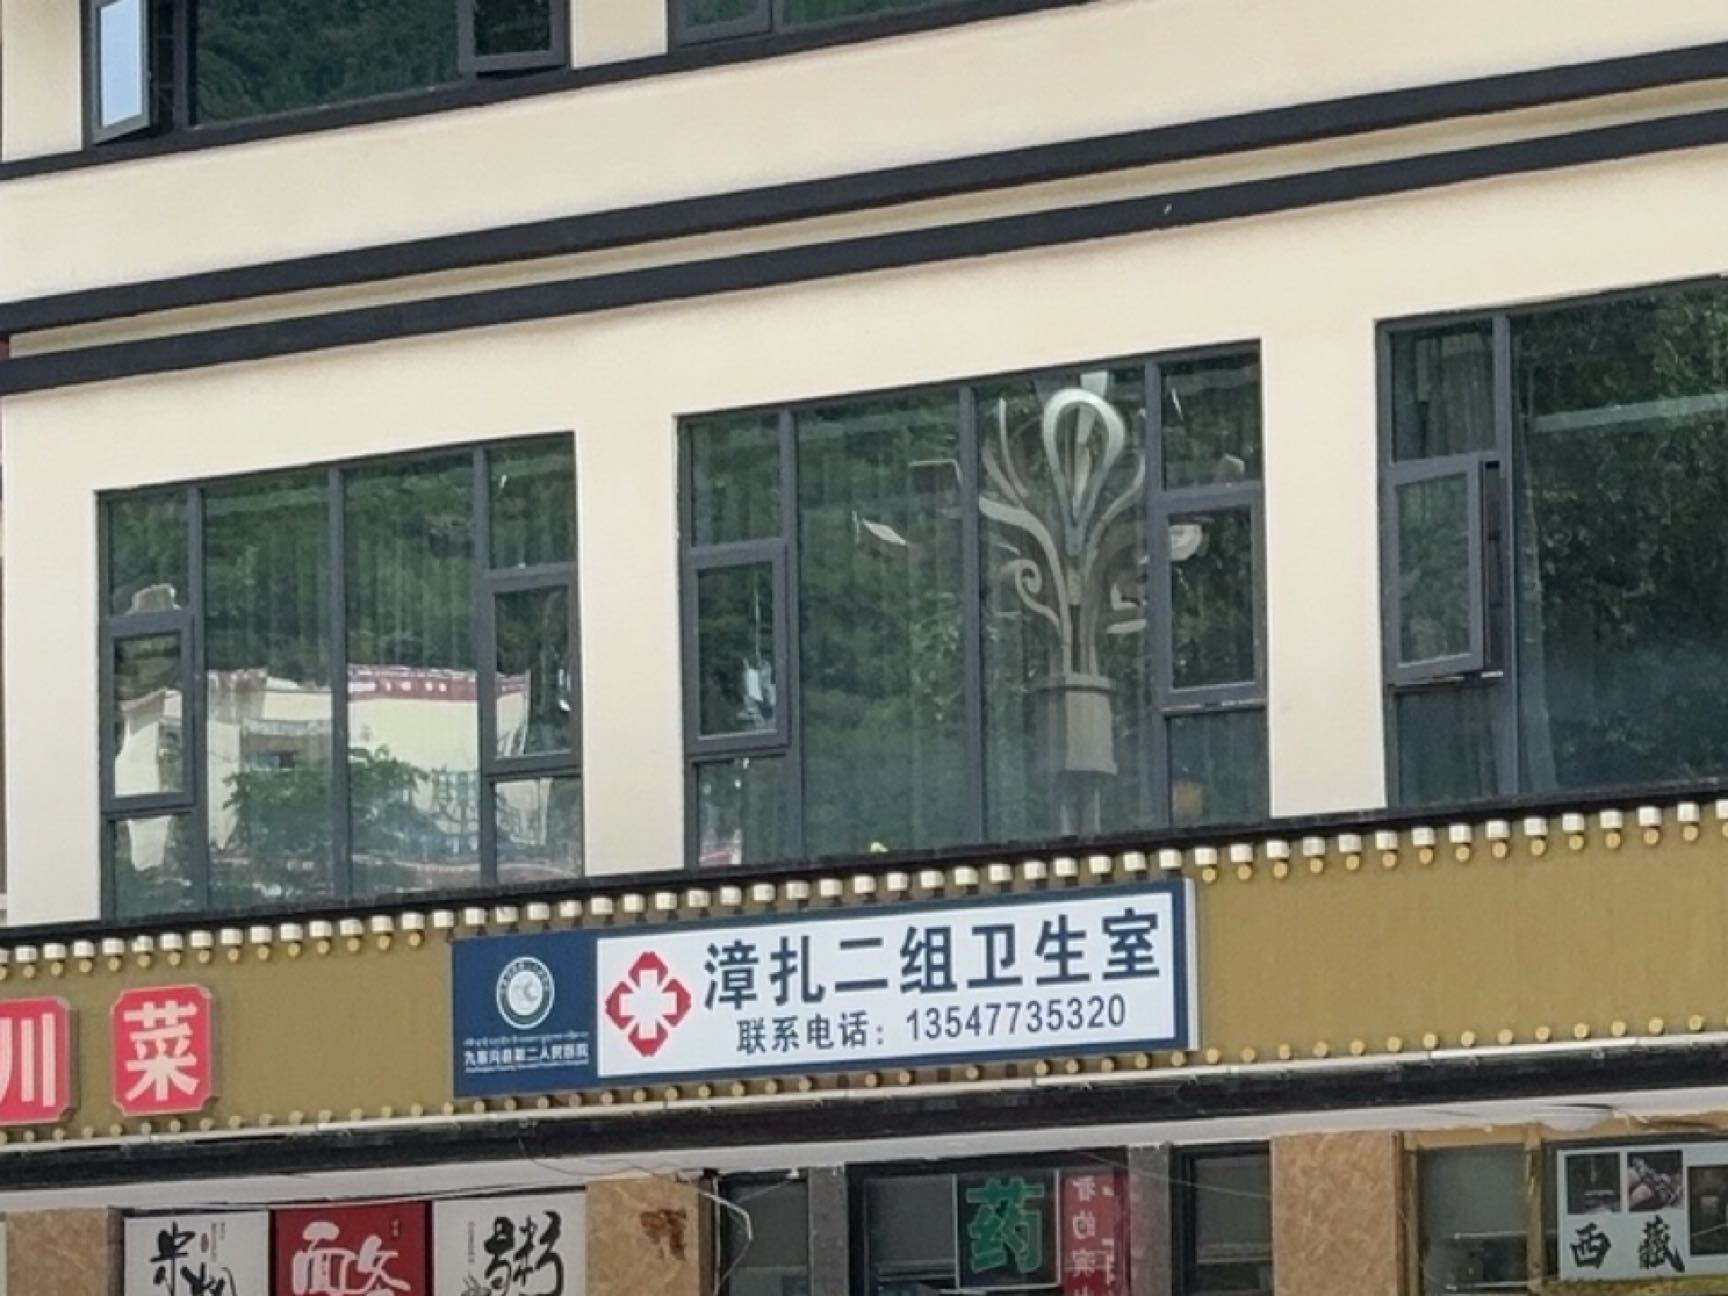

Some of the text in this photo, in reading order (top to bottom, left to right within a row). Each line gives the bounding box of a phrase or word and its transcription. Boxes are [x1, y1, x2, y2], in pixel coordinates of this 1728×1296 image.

[704, 907, 1160, 1010] 漳扎二组卫生室
[966, 1175, 1045, 1274] 药
